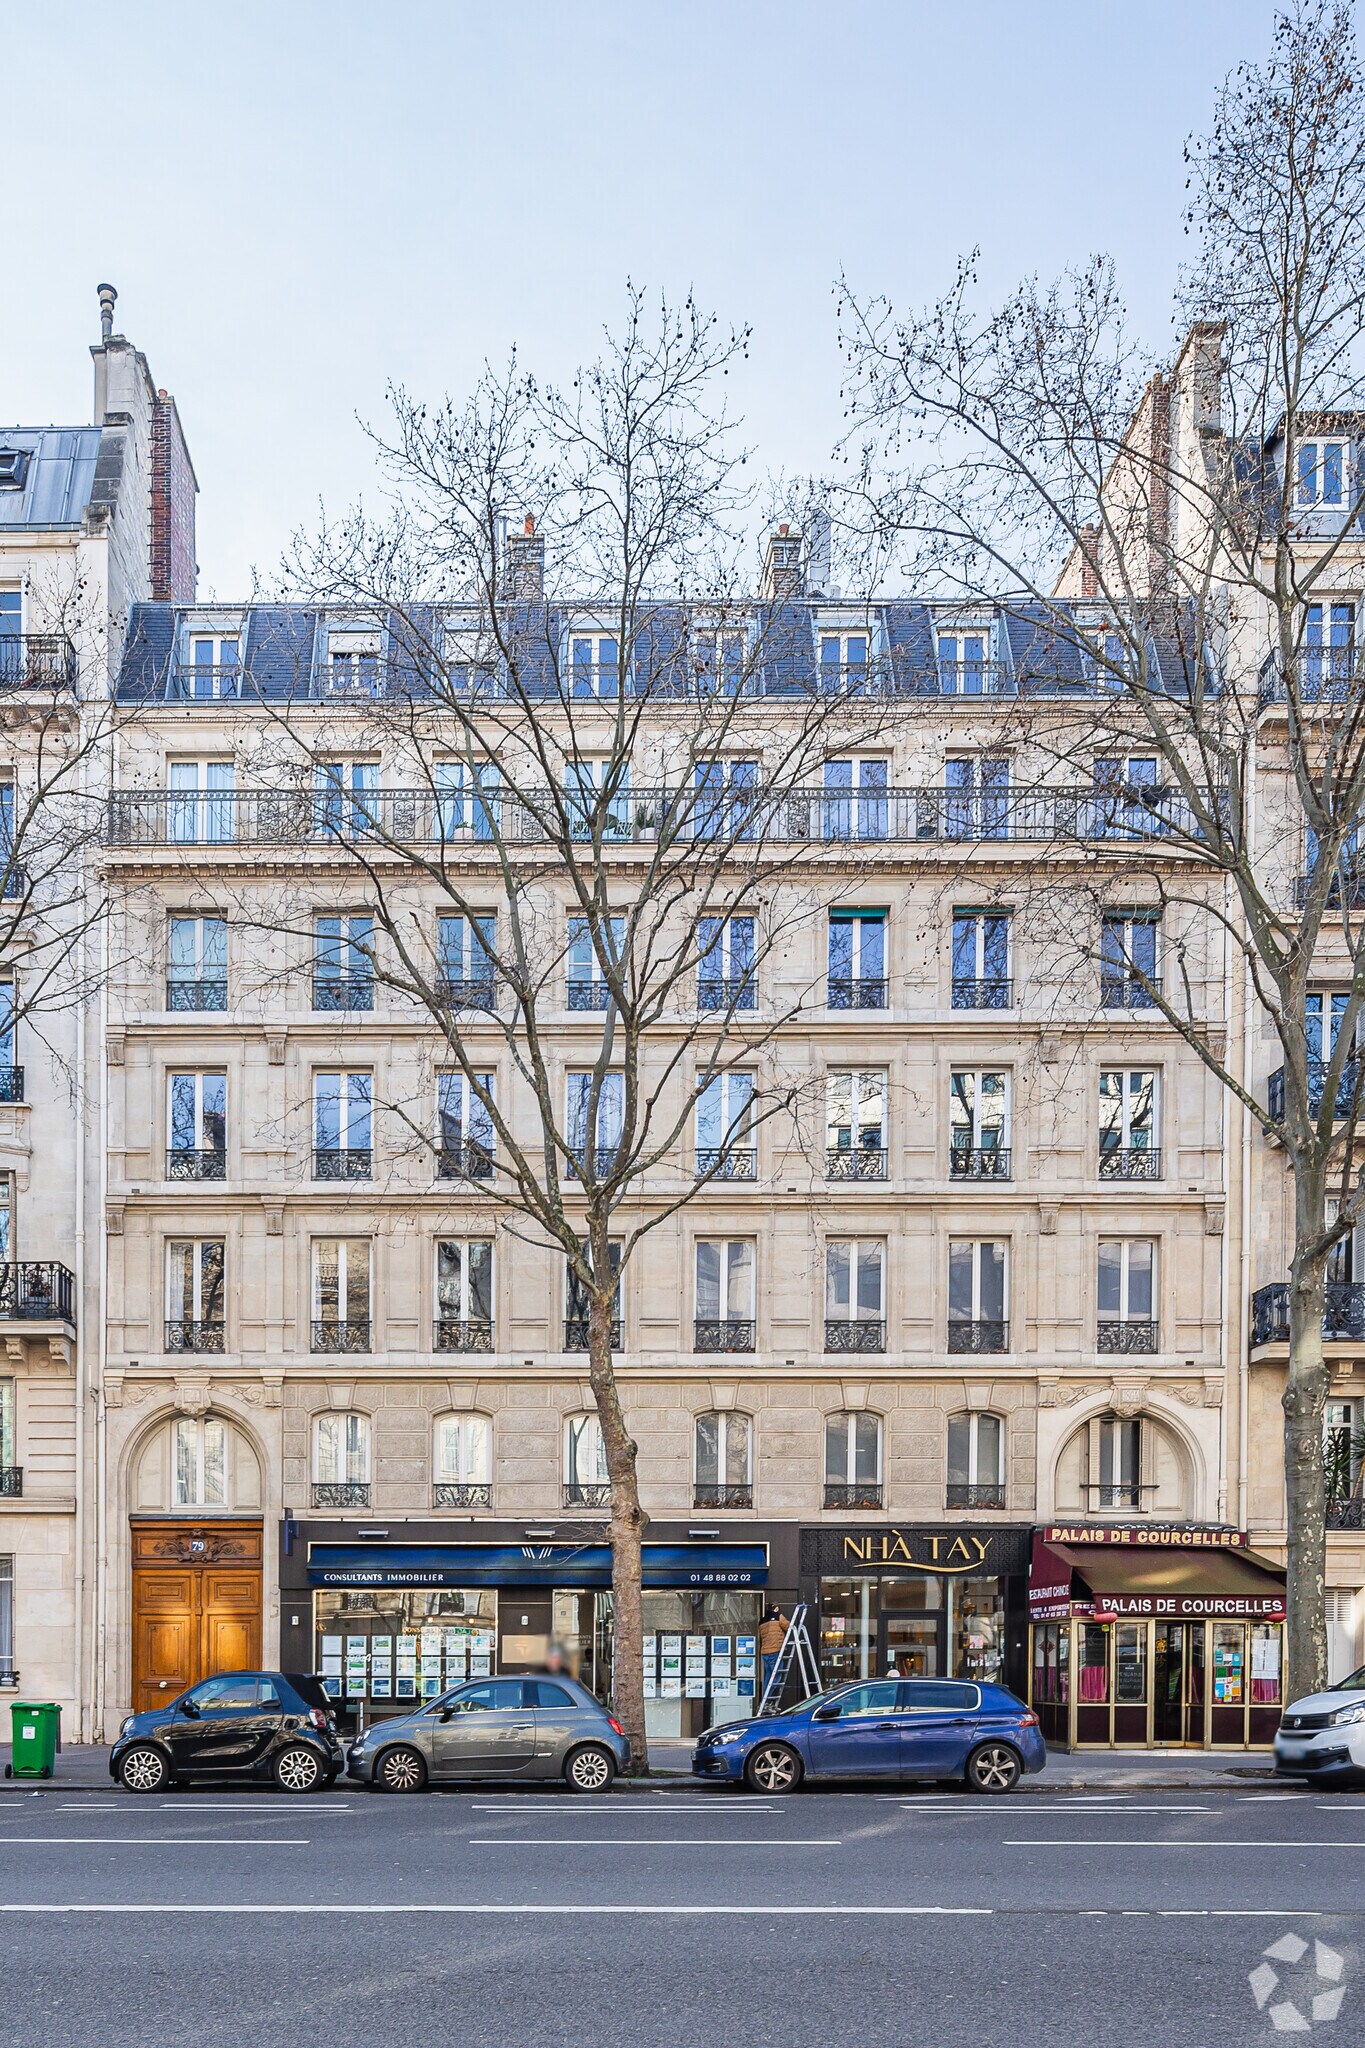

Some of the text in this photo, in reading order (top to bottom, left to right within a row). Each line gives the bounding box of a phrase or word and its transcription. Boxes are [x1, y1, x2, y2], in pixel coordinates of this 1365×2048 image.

[1051, 1528, 1241, 1546] PALAIS DE COURCELLES
[192, 1541, 204, 1551] 79
[844, 1529, 993, 1560] NHÀ TAY
[323, 1573, 444, 1581] CONSULTANTS IMMOBILIER
[740, 1573, 751, 1581] 02
[1102, 1598, 1152, 1612] PALAIS
[1156, 1599, 1176, 1612] DE
[1181, 1600, 1283, 1613] COURCELLES
